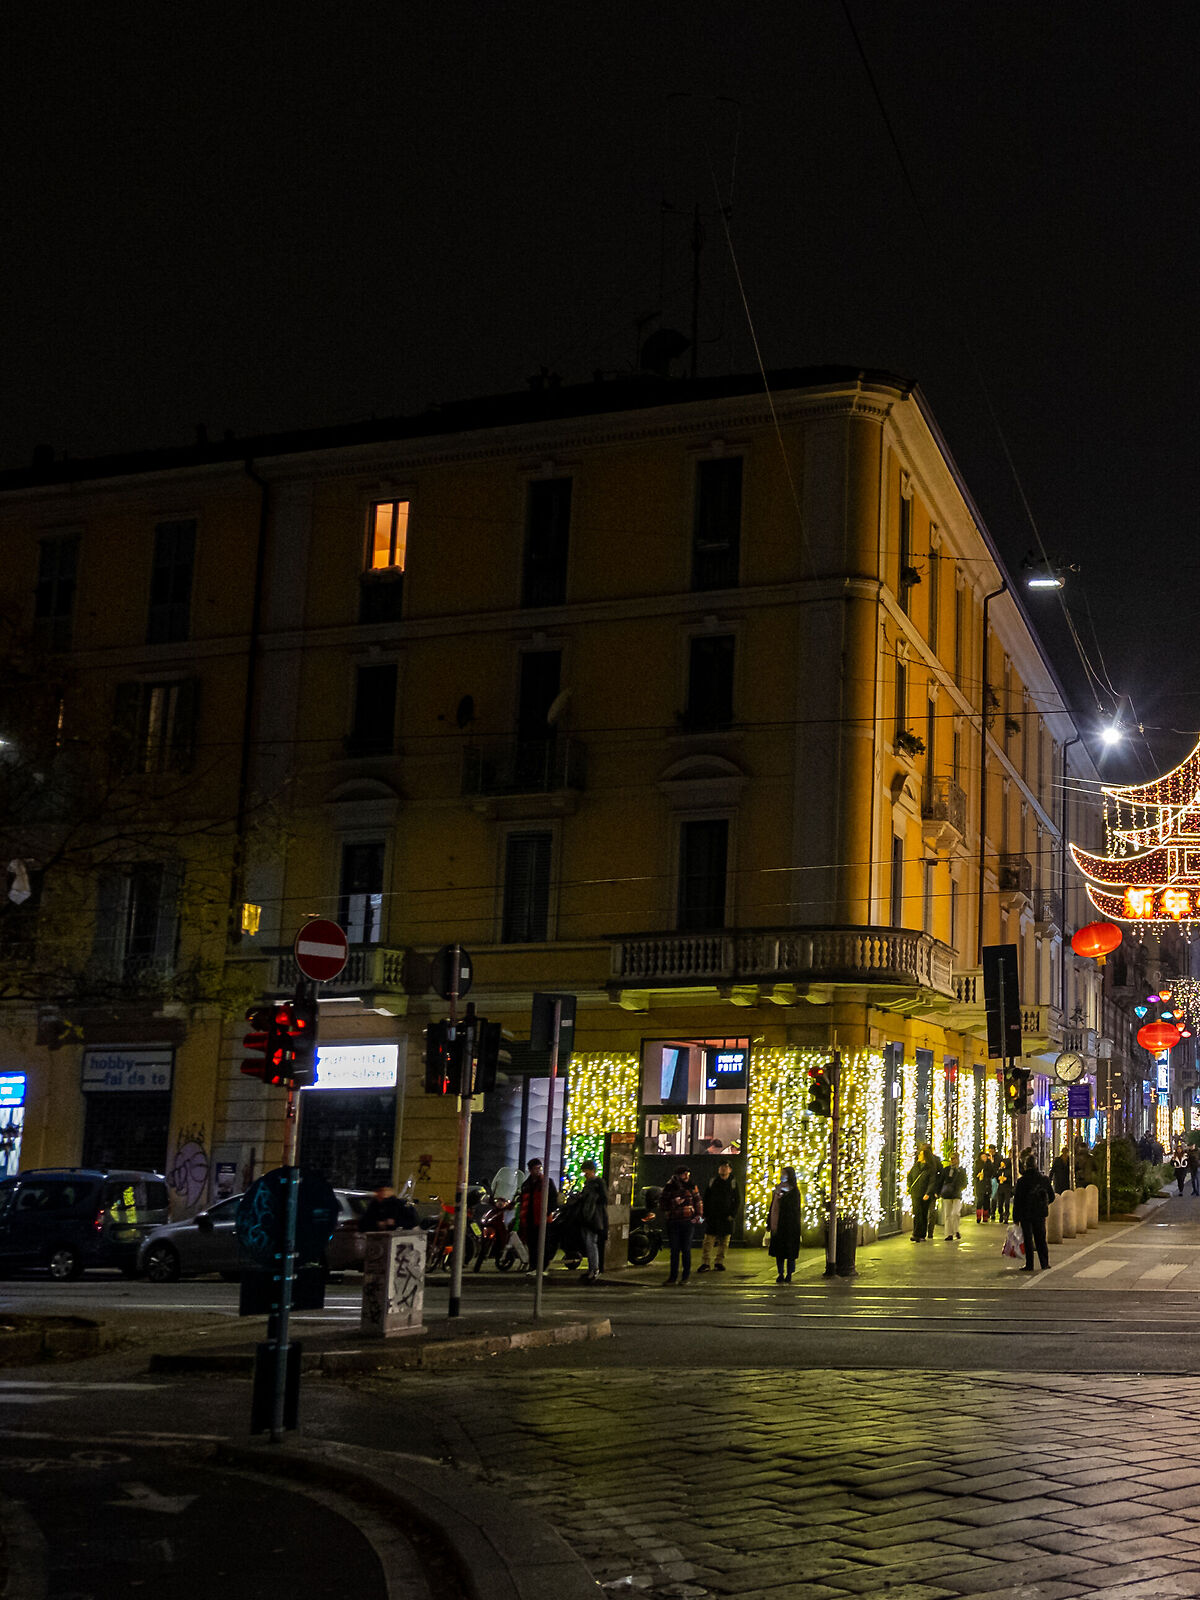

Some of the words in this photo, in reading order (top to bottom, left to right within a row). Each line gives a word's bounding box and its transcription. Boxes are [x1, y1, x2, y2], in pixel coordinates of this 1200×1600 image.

[90, 1056, 135, 1072] hobby
[717, 1063, 743, 1072] POINT
[104, 1072, 122, 1085] fai
[128, 1071, 145, 1085] da
[152, 1073, 166, 1084] te
